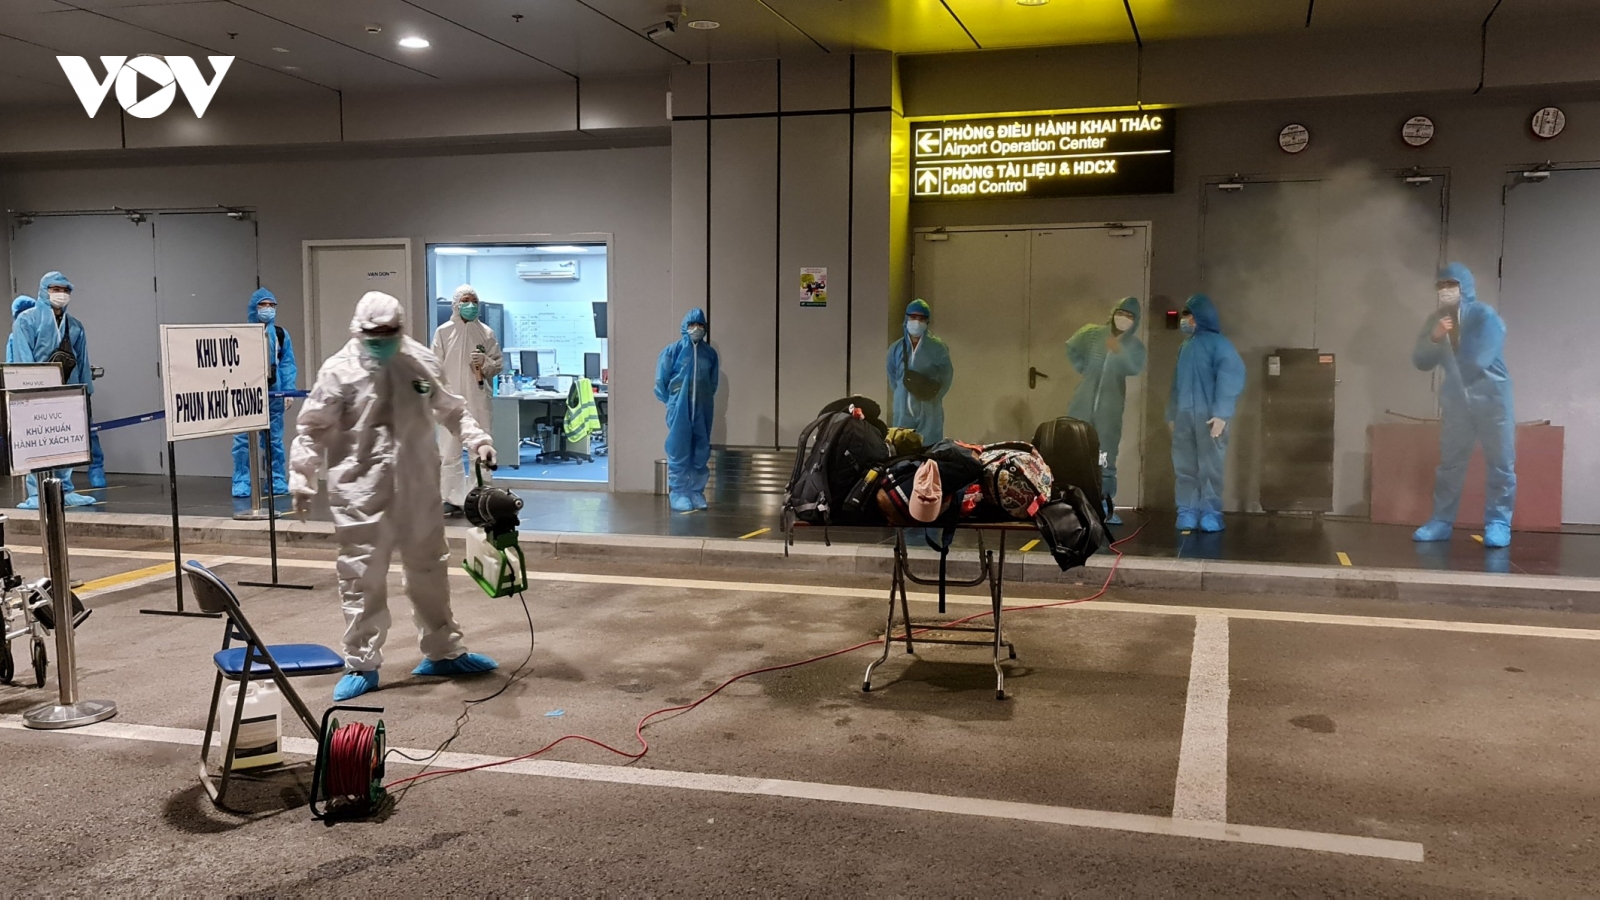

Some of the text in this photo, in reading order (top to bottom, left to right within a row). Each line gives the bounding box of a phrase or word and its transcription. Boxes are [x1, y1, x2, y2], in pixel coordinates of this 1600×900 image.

[943, 114, 1162, 141] PHÒNG ĐIỀU HÀNH KHAI THÁC
[943, 136, 1107, 158] Airport Operation Center
[943, 160, 1116, 180] PHÒNG TÀI LIỆU & HDCX
[943, 178, 1028, 195] Load Control
[195, 334, 240, 373] KHU VỰC
[175, 379, 263, 424] PHUN KHỬ TRÙNG
[13, 434, 84, 449] HÀNH LÝ XÁCH TAY
